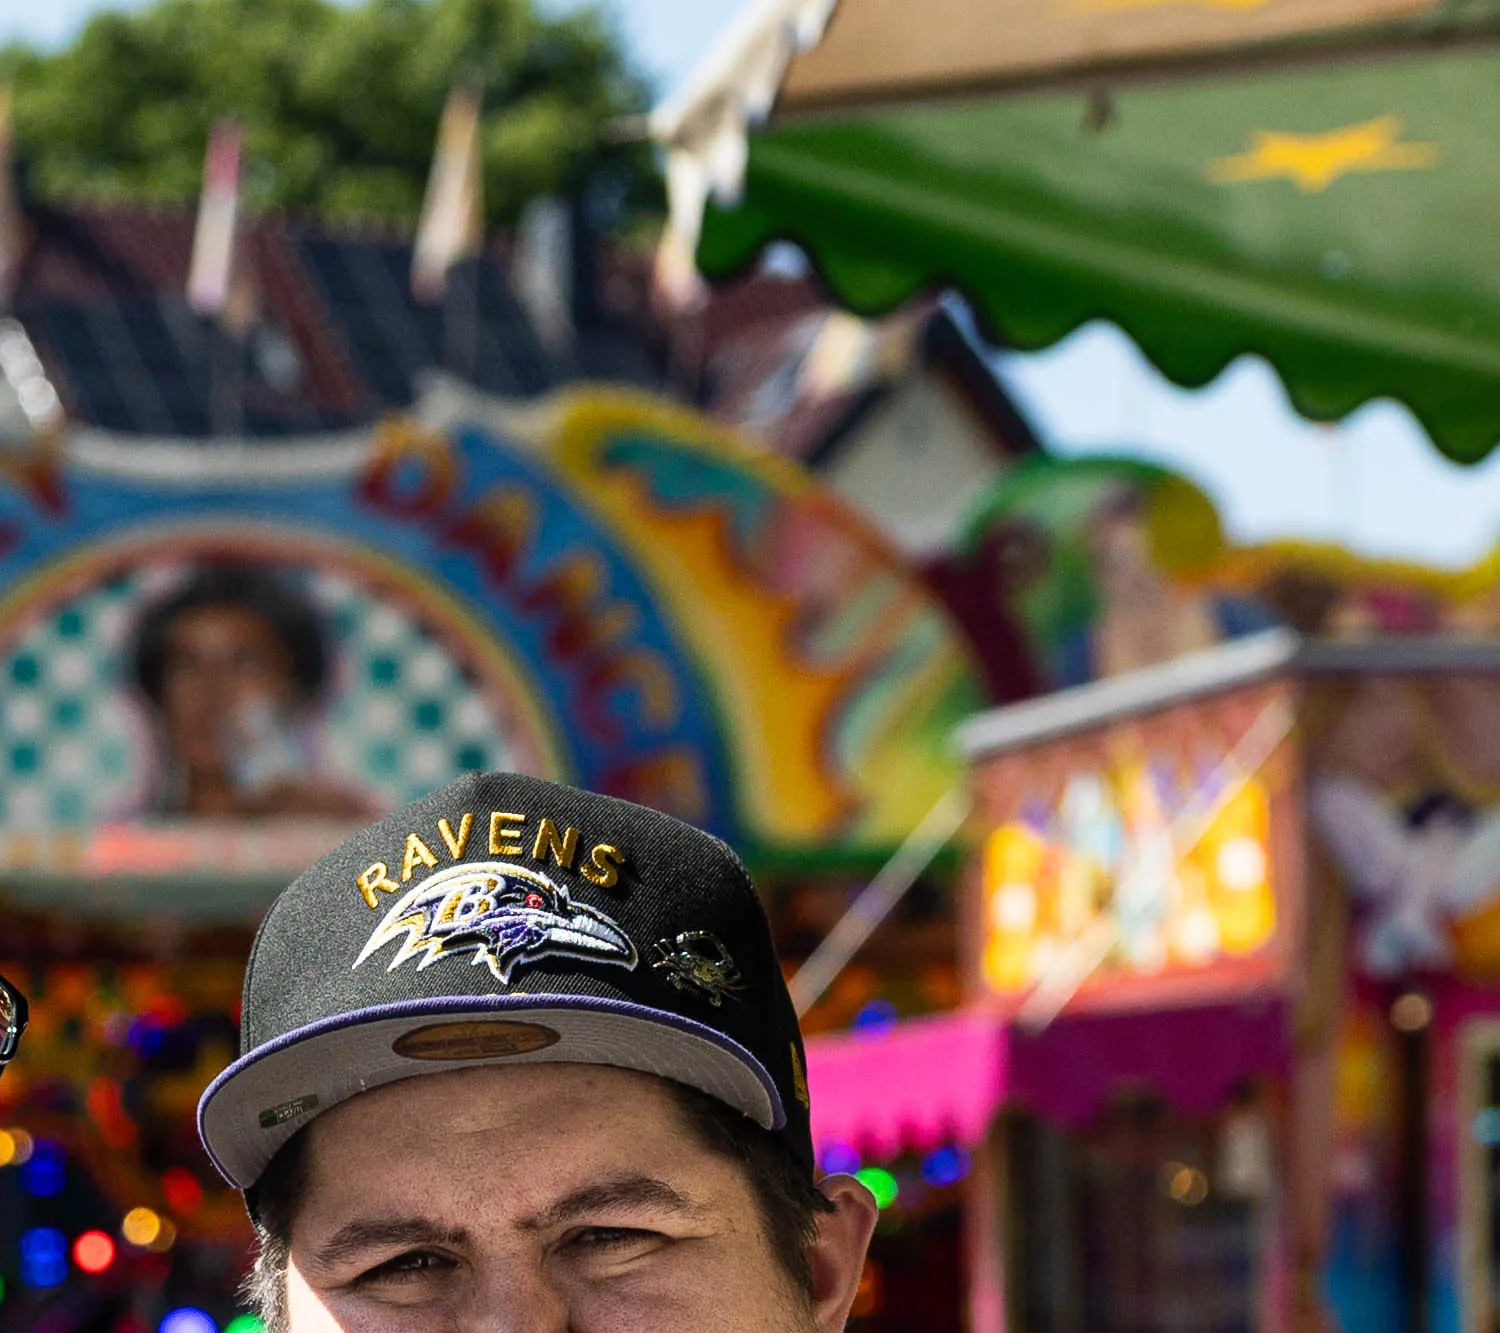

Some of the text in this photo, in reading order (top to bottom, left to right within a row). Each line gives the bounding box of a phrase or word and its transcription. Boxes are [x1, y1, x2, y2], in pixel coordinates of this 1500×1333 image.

[353, 418, 706, 826] DANCE
[357, 811, 624, 909] RAVENS
[430, 872, 506, 936] B
